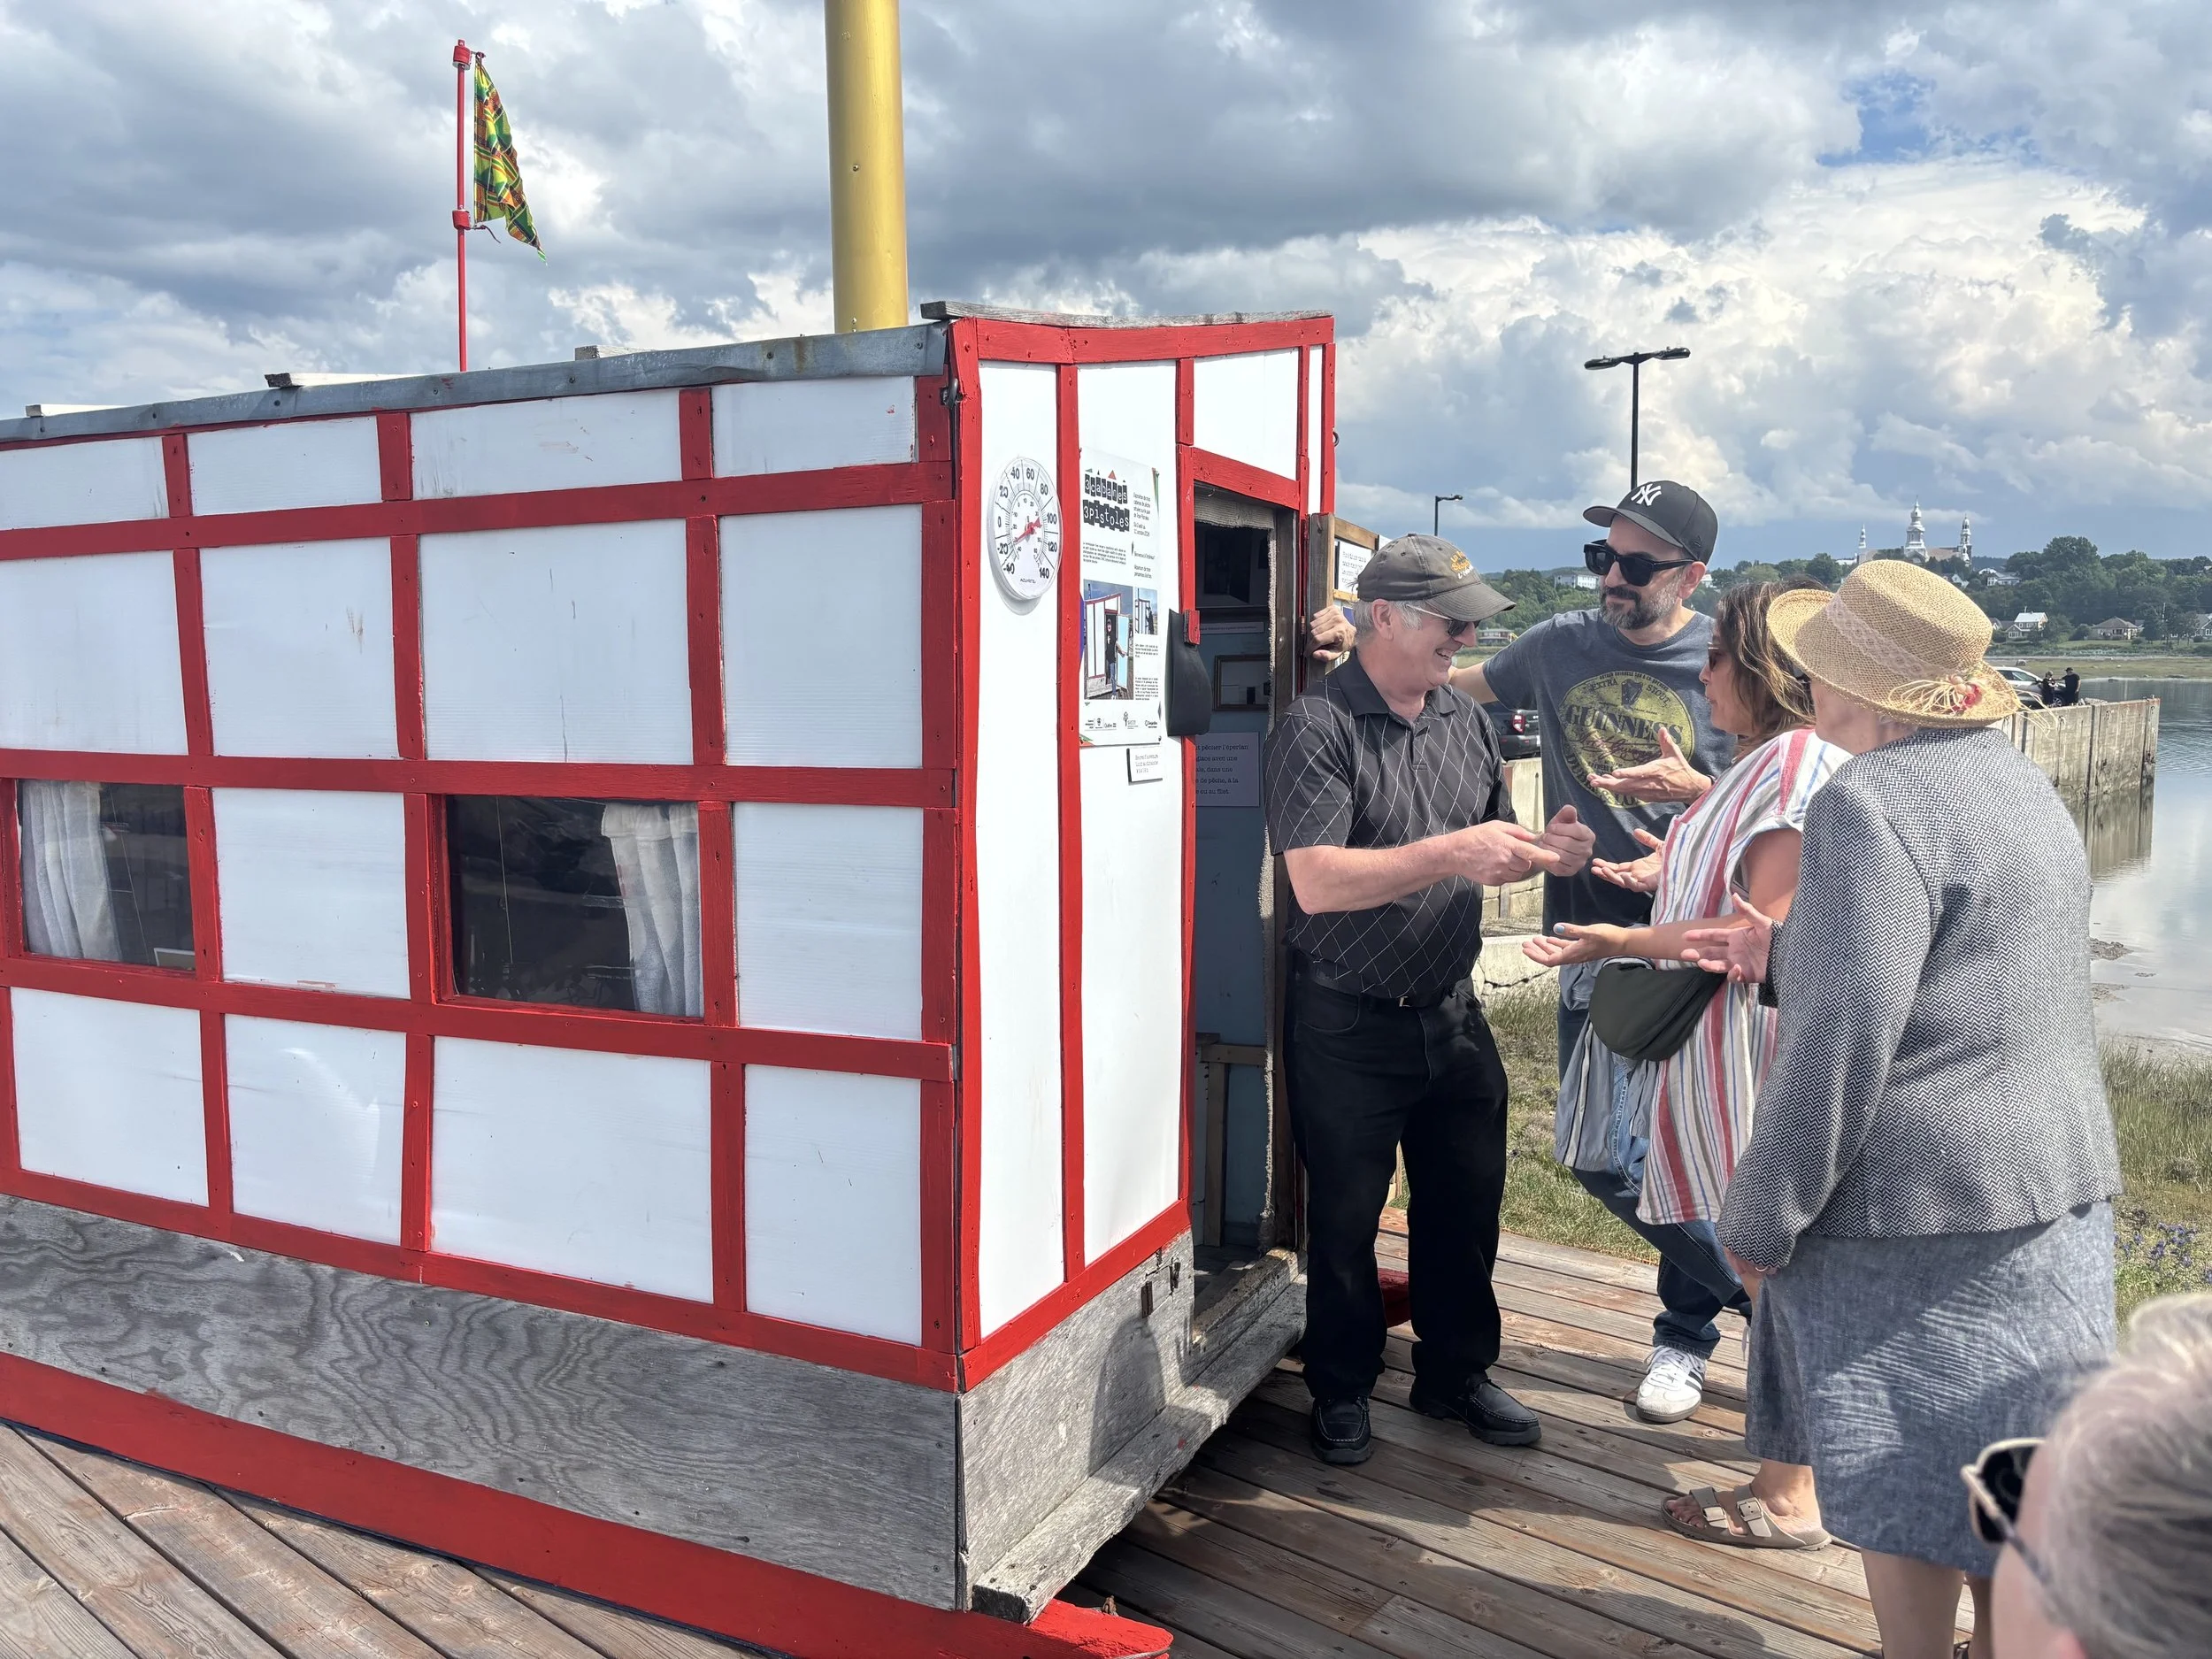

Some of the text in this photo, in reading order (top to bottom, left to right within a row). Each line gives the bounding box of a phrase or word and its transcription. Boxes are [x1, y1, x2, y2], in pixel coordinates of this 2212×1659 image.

[1010, 467, 1020, 480] 40
[1025, 467, 1034, 480] 60
[999, 485, 1009, 498] 20
[1040, 483, 1048, 495] 80
[1631, 483, 1662, 506] NY
[997, 516, 1002, 527] 0
[1047, 512, 1057, 525] 100
[997, 542, 1009, 555] -20
[1048, 541, 1057, 553] 120
[1003, 562, 1015, 574] -40
[1039, 567, 1049, 579] 140
[1592, 678, 1618, 691] EXTRA
[1565, 705, 1683, 745] GUINNESS
